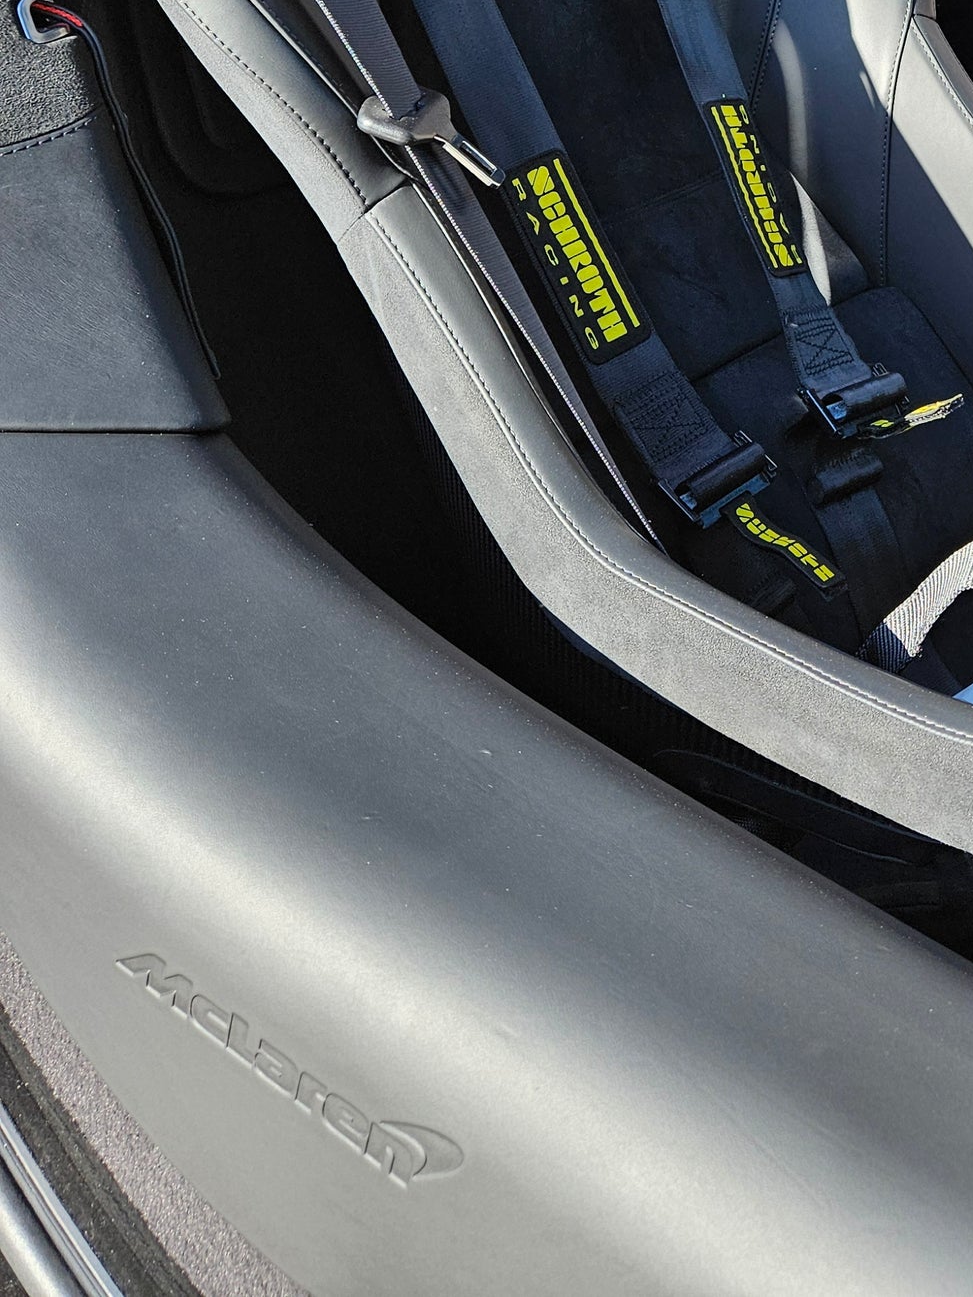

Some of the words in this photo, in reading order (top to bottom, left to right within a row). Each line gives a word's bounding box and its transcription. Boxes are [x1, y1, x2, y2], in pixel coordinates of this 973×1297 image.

[511, 177, 601, 350] RACING
[526, 165, 628, 343] SCHROTH
[720, 104, 794, 267] SCHROTH
[735, 502, 835, 582] SCHROTH
[114, 952, 416, 1190] McLaren
